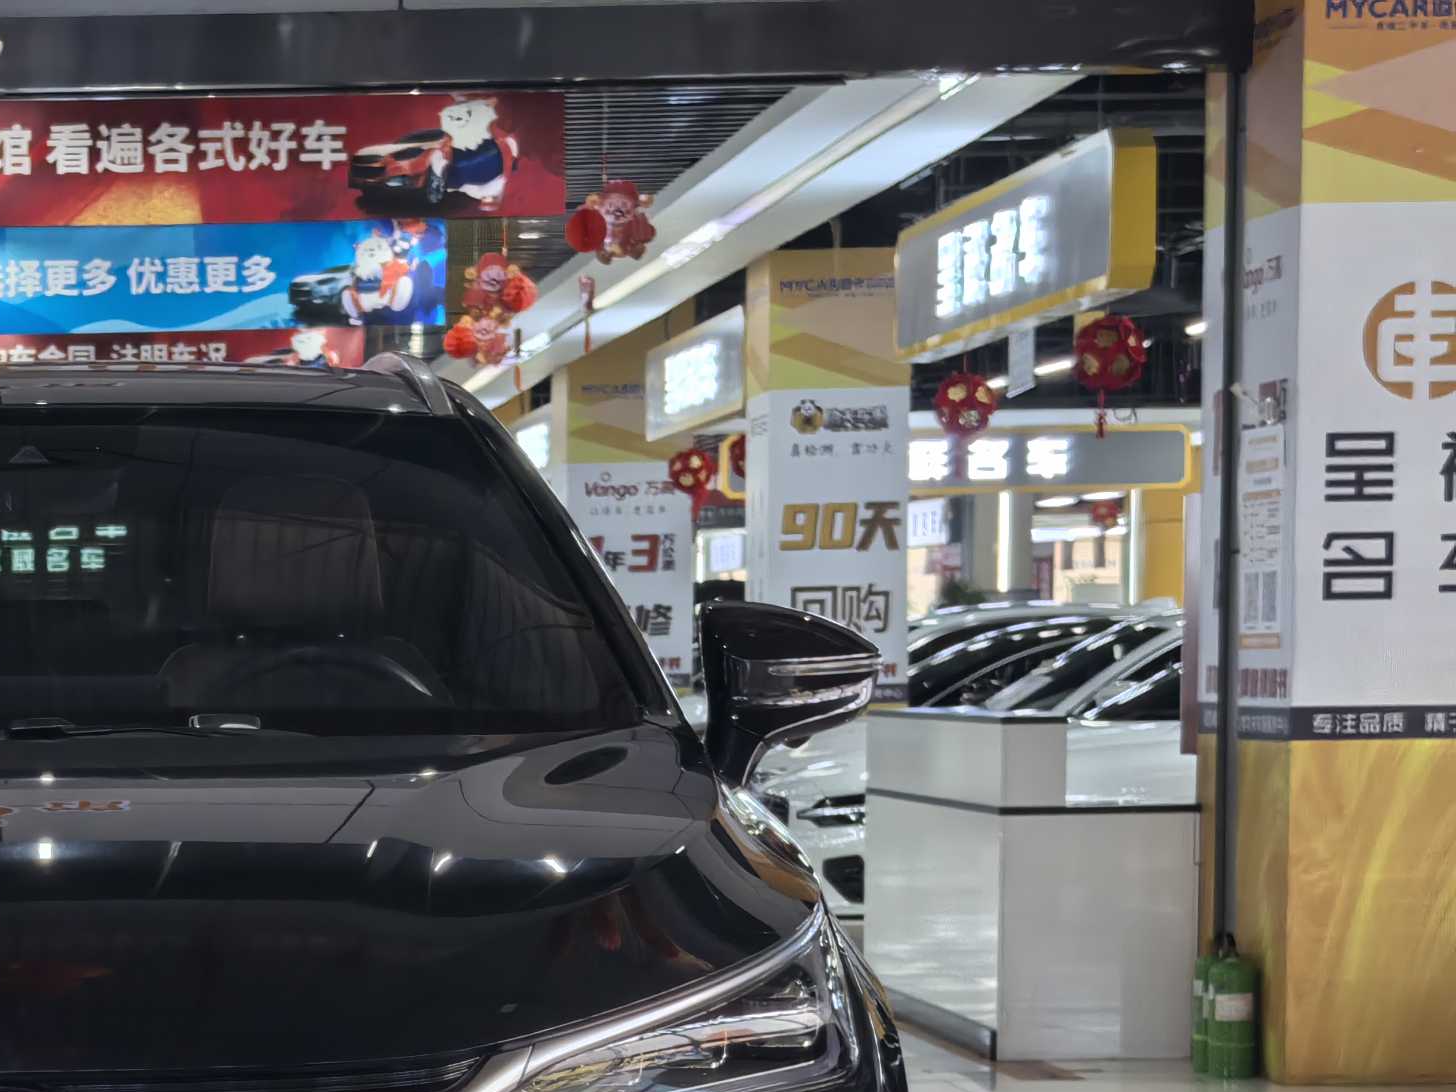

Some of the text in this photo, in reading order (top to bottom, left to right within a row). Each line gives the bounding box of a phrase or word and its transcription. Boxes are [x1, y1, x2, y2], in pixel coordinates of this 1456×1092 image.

[46, 120, 347, 176] 看遍各式好车
[127, 256, 276, 296] 优惠更多
[778, 502, 902, 552] 90天
[1312, 711, 1405, 735] 专注品质
